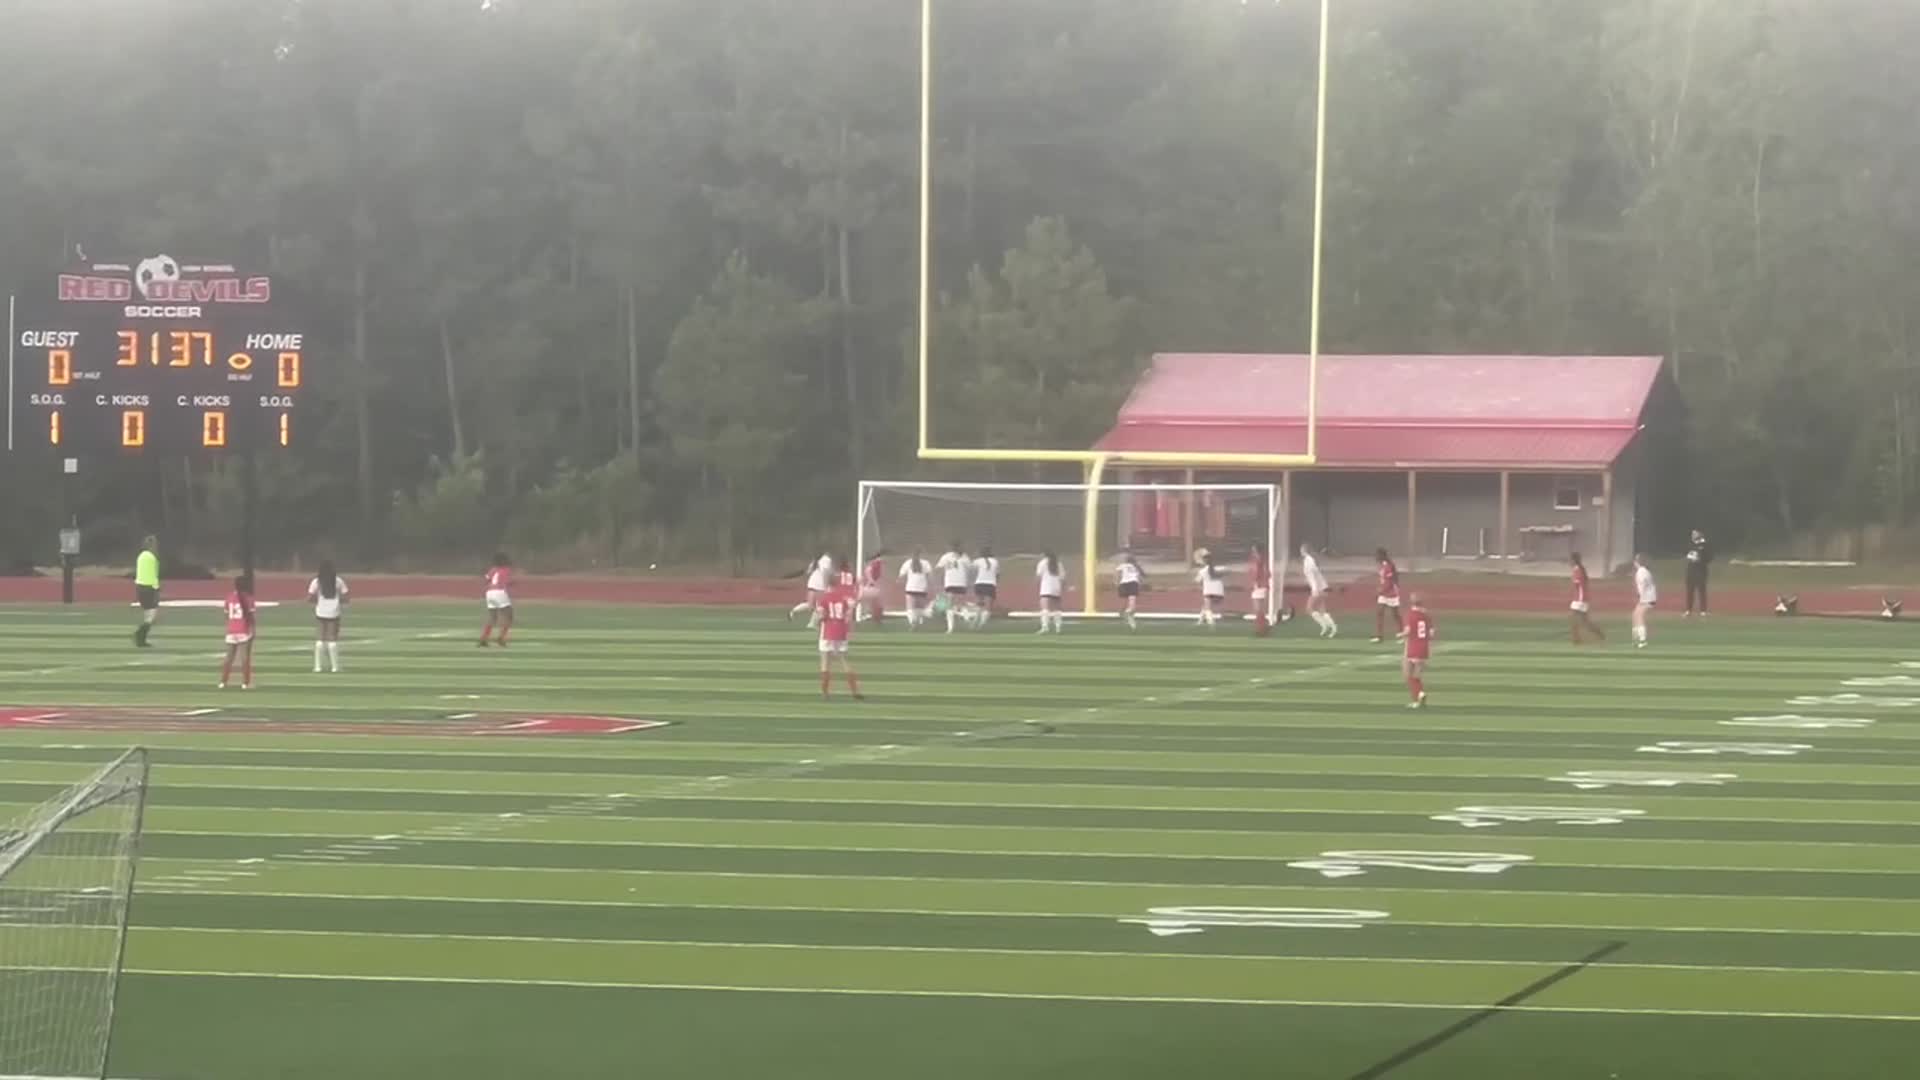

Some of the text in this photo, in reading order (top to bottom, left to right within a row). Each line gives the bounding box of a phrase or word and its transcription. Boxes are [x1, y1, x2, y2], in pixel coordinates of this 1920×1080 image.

[58, 275, 270, 303] RED DEVILS
[124, 305, 202, 318] SOCCER
[21, 330, 79, 347] GUEST
[246, 333, 303, 350] HOME
[48, 350, 70, 384] 0
[278, 352, 300, 387] 0
[111, 394, 150, 406] KICKS
[193, 394, 231, 406] KICKS
[50, 411, 59, 445] 1
[122, 411, 144, 446] 0
[203, 411, 225, 446] 0
[280, 412, 288, 446] 1
